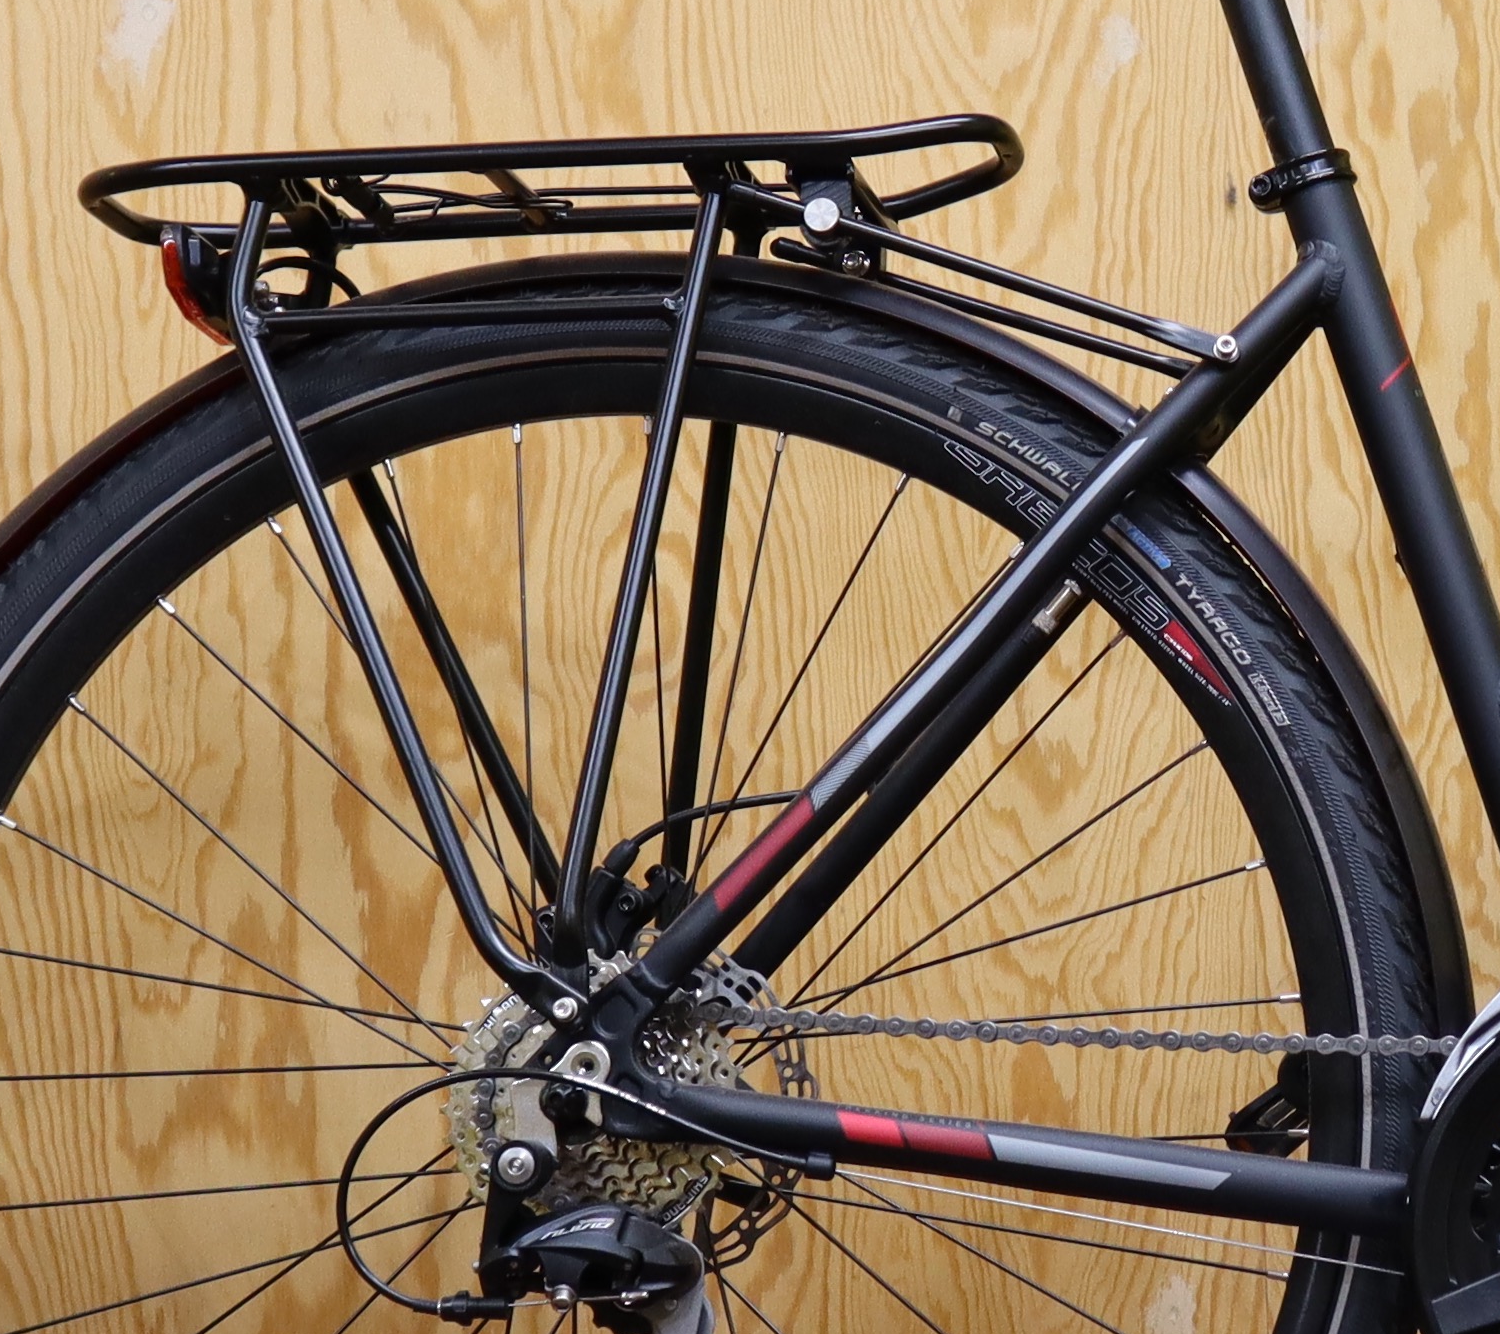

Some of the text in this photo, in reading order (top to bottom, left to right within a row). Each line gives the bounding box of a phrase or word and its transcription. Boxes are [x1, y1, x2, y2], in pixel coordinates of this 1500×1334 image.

[974, 421, 1087, 492] SCHWAL
[943, 439, 1172, 633] GREOS
[1174, 572, 1253, 667] TYRAGO
